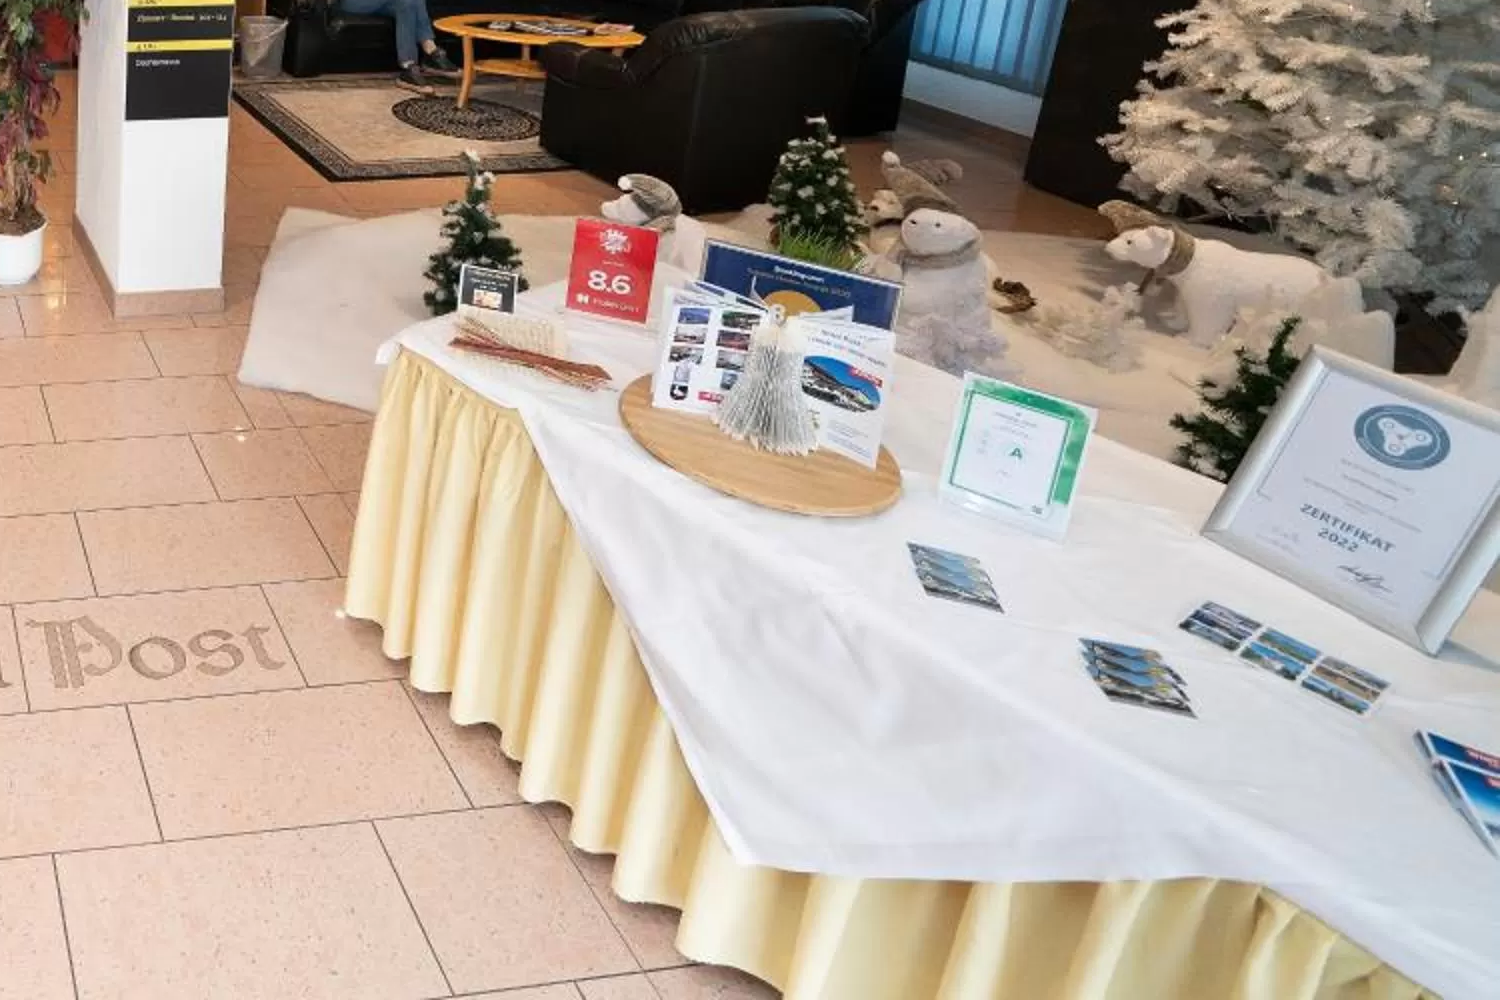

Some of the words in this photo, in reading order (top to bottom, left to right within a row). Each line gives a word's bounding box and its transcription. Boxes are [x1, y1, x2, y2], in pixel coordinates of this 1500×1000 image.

[587, 269, 632, 295] 8.6
[1300, 503, 1397, 553] ZERTIFIKAT
[1316, 526, 1360, 553] 2022
[25, 614, 287, 689] Post
